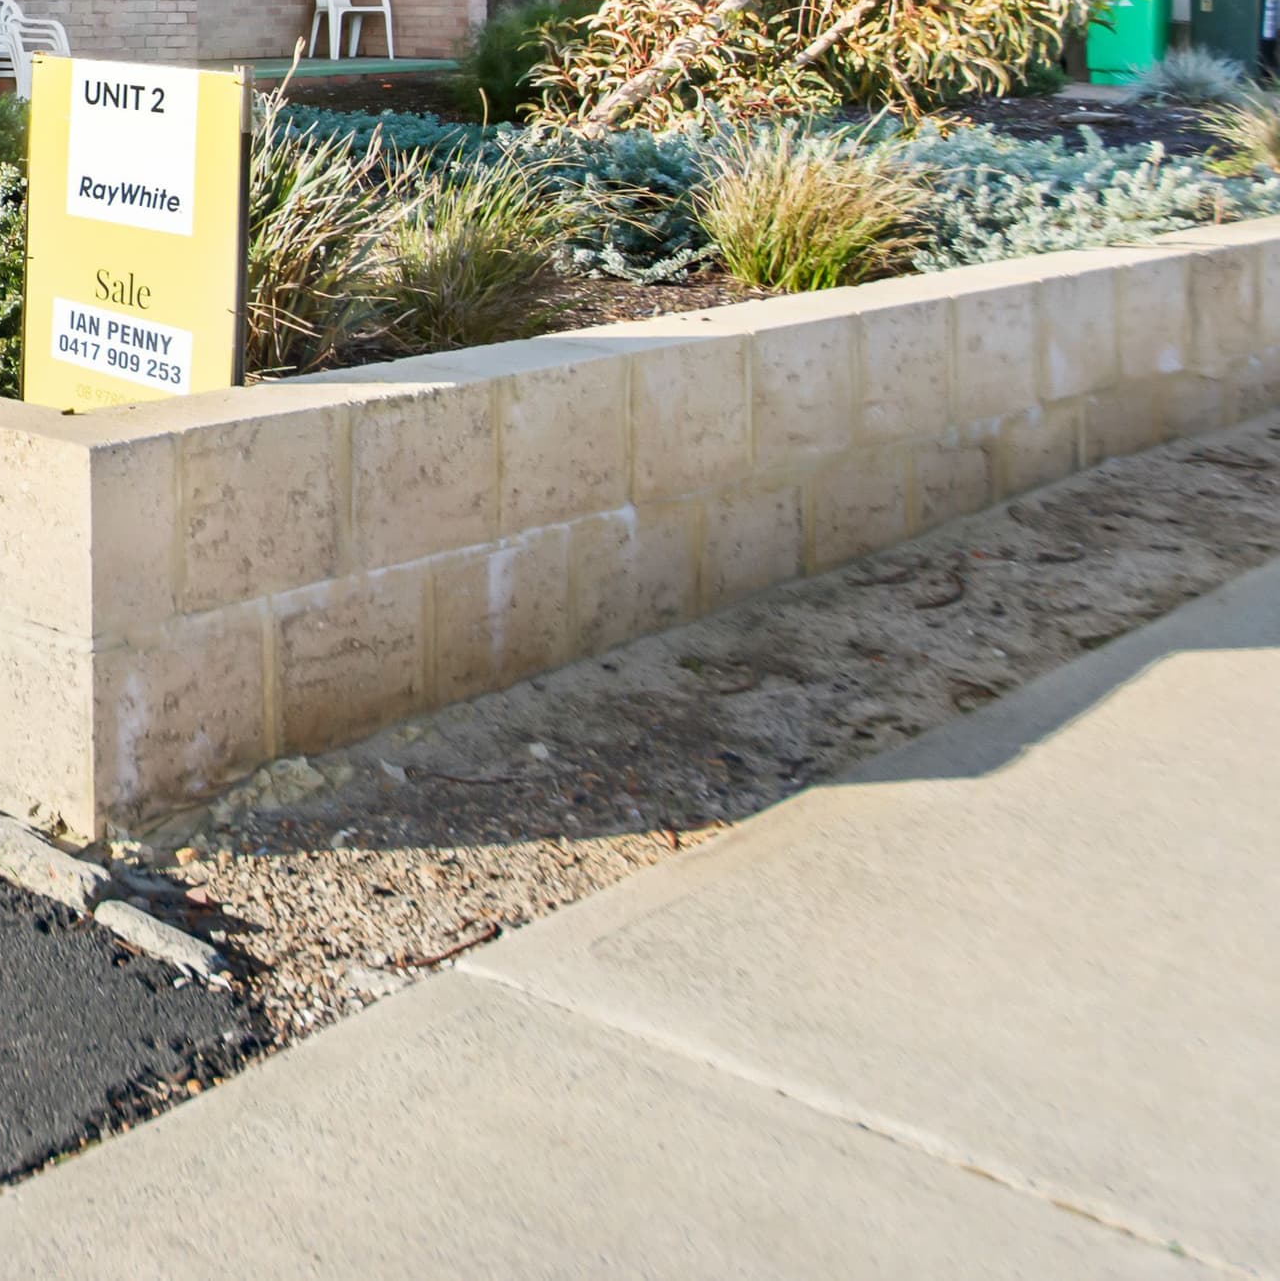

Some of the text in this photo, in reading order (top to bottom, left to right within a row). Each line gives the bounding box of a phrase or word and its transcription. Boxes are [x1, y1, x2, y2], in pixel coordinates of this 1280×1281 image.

[85, 80, 165, 114] UNIT 2
[79, 175, 180, 212] RayWhite
[95, 269, 151, 310] Sale
[70, 310, 172, 355] IAN PENNY
[59, 334, 181, 384] 0417 909 253
